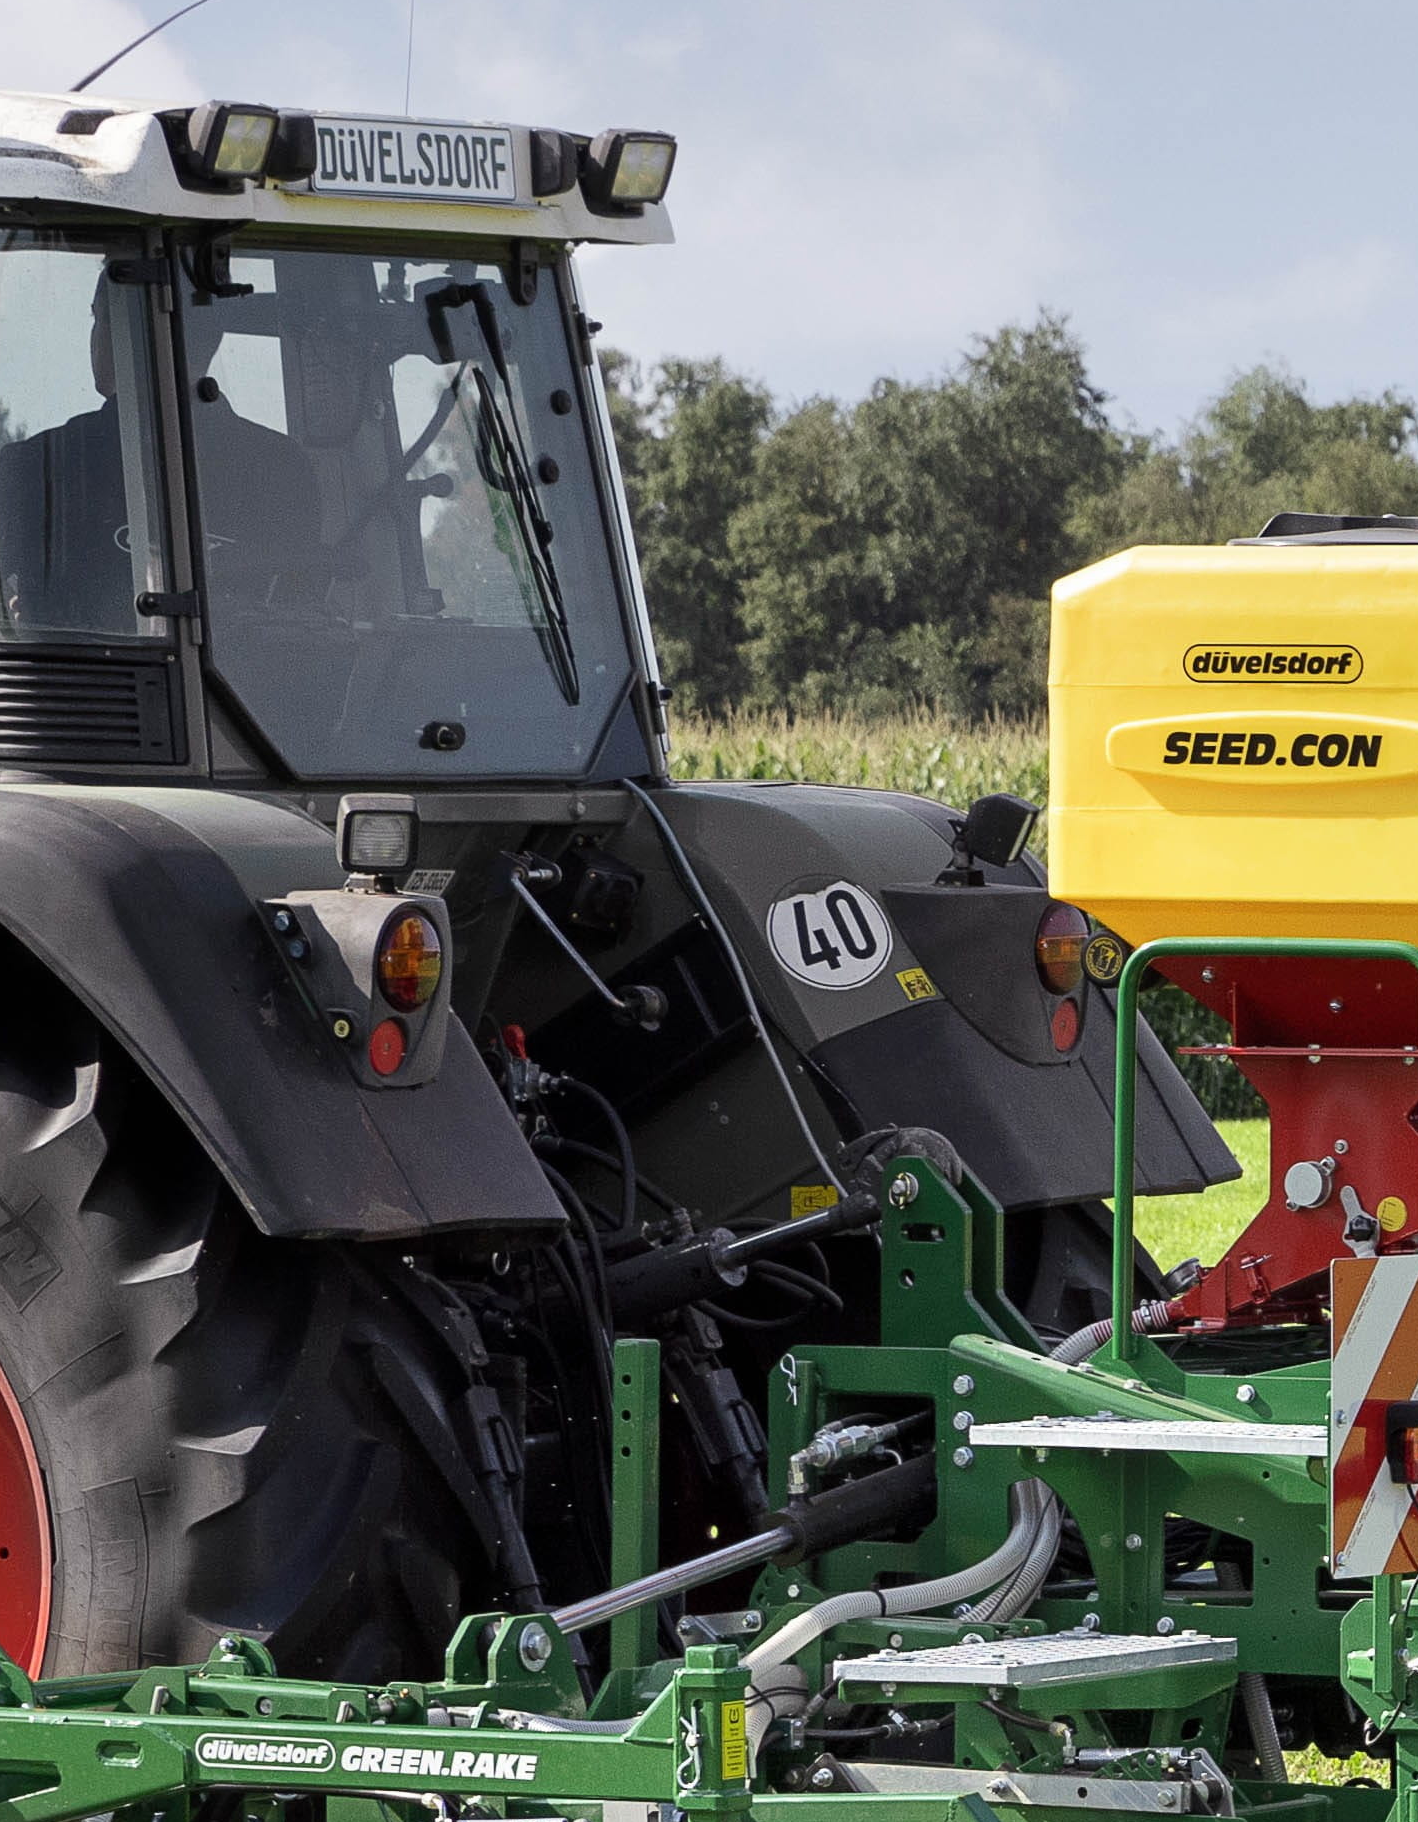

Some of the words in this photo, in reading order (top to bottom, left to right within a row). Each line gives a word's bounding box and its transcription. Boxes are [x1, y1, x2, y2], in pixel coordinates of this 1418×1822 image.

[318, 127, 506, 190] DÜVELSDORF
[1192, 651, 1353, 675] düvelsdorf
[1163, 731, 1383, 768] SEED.CON
[793, 889, 877, 970] 40
[202, 1741, 328, 1764] düvelsdorf
[340, 1745, 538, 1780] GREEN.RAKE
